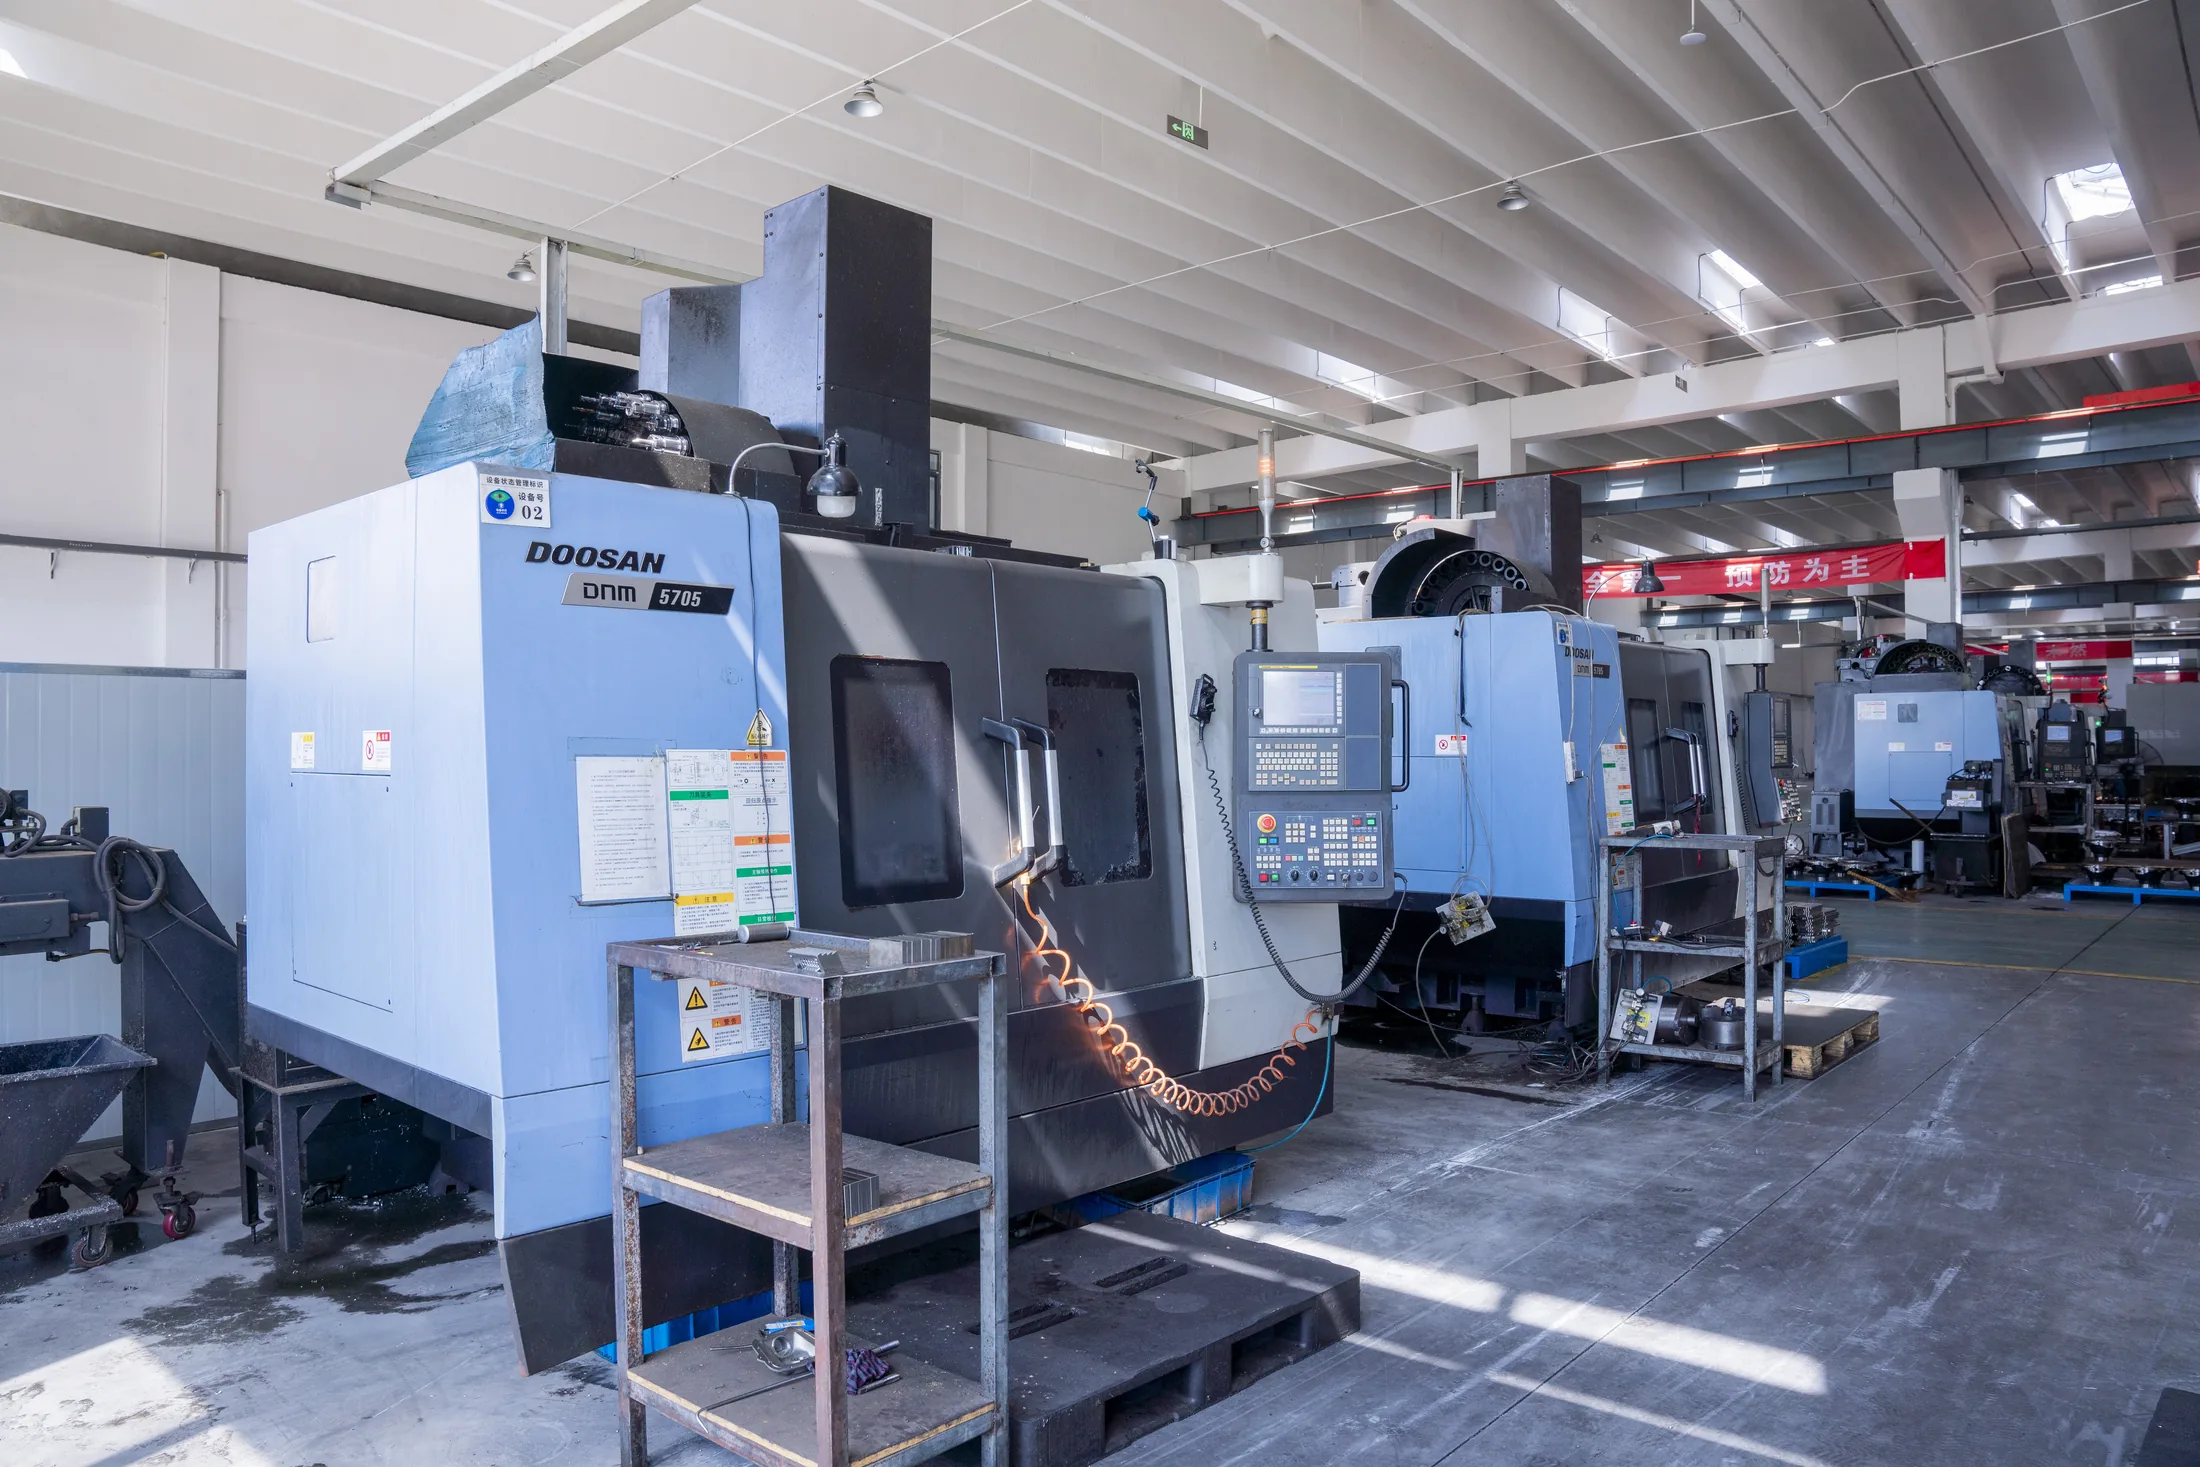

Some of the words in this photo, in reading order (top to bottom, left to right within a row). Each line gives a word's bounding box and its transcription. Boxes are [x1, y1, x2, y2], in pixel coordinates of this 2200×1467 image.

[486, 476, 544, 489] 设备状态管理标识
[518, 491, 545, 503] 设备号
[521, 505, 544, 521] 02
[525, 541, 666, 574] DOOSAN
[1724, 554, 1870, 588] 预防为主
[659, 588, 703, 607] 5705
